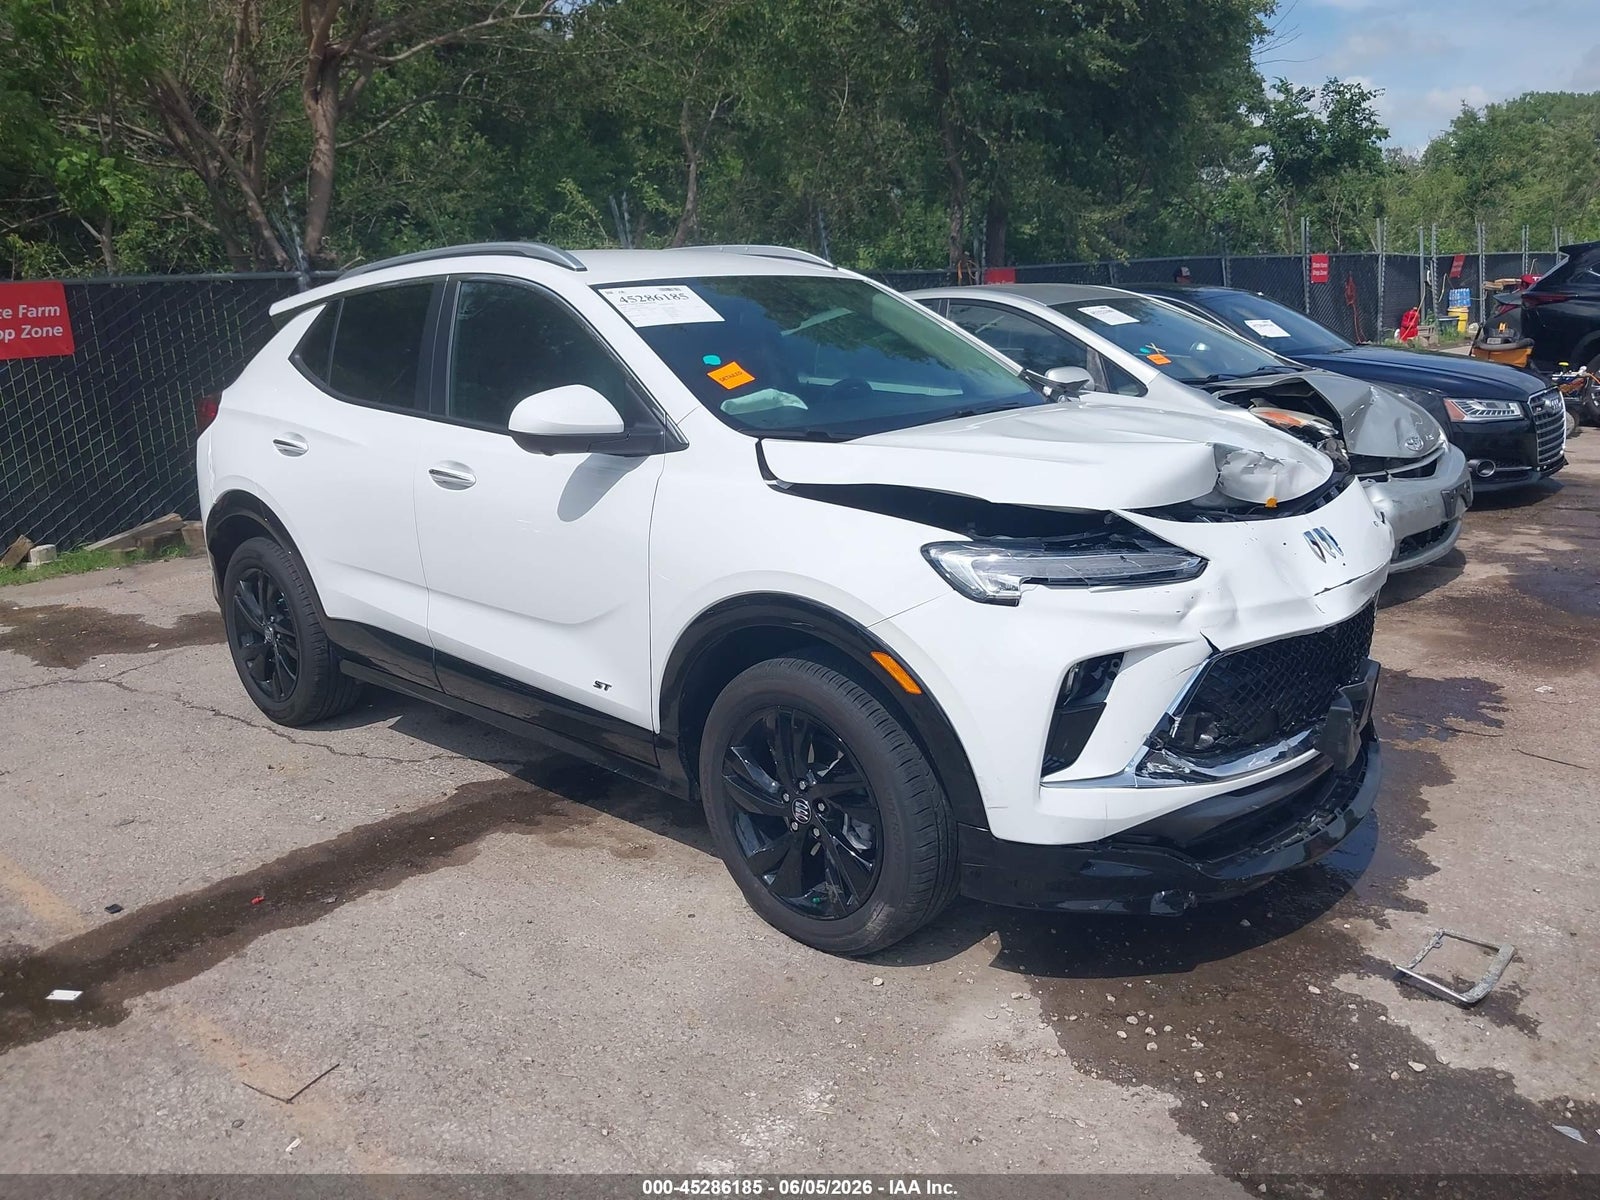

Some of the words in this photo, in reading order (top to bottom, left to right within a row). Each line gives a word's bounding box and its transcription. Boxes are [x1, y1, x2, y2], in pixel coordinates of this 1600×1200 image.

[619, 292, 689, 304] 45286185
[18, 304, 60, 318] Farm
[20, 325, 63, 339] Zone
[592, 680, 612, 691] ST
